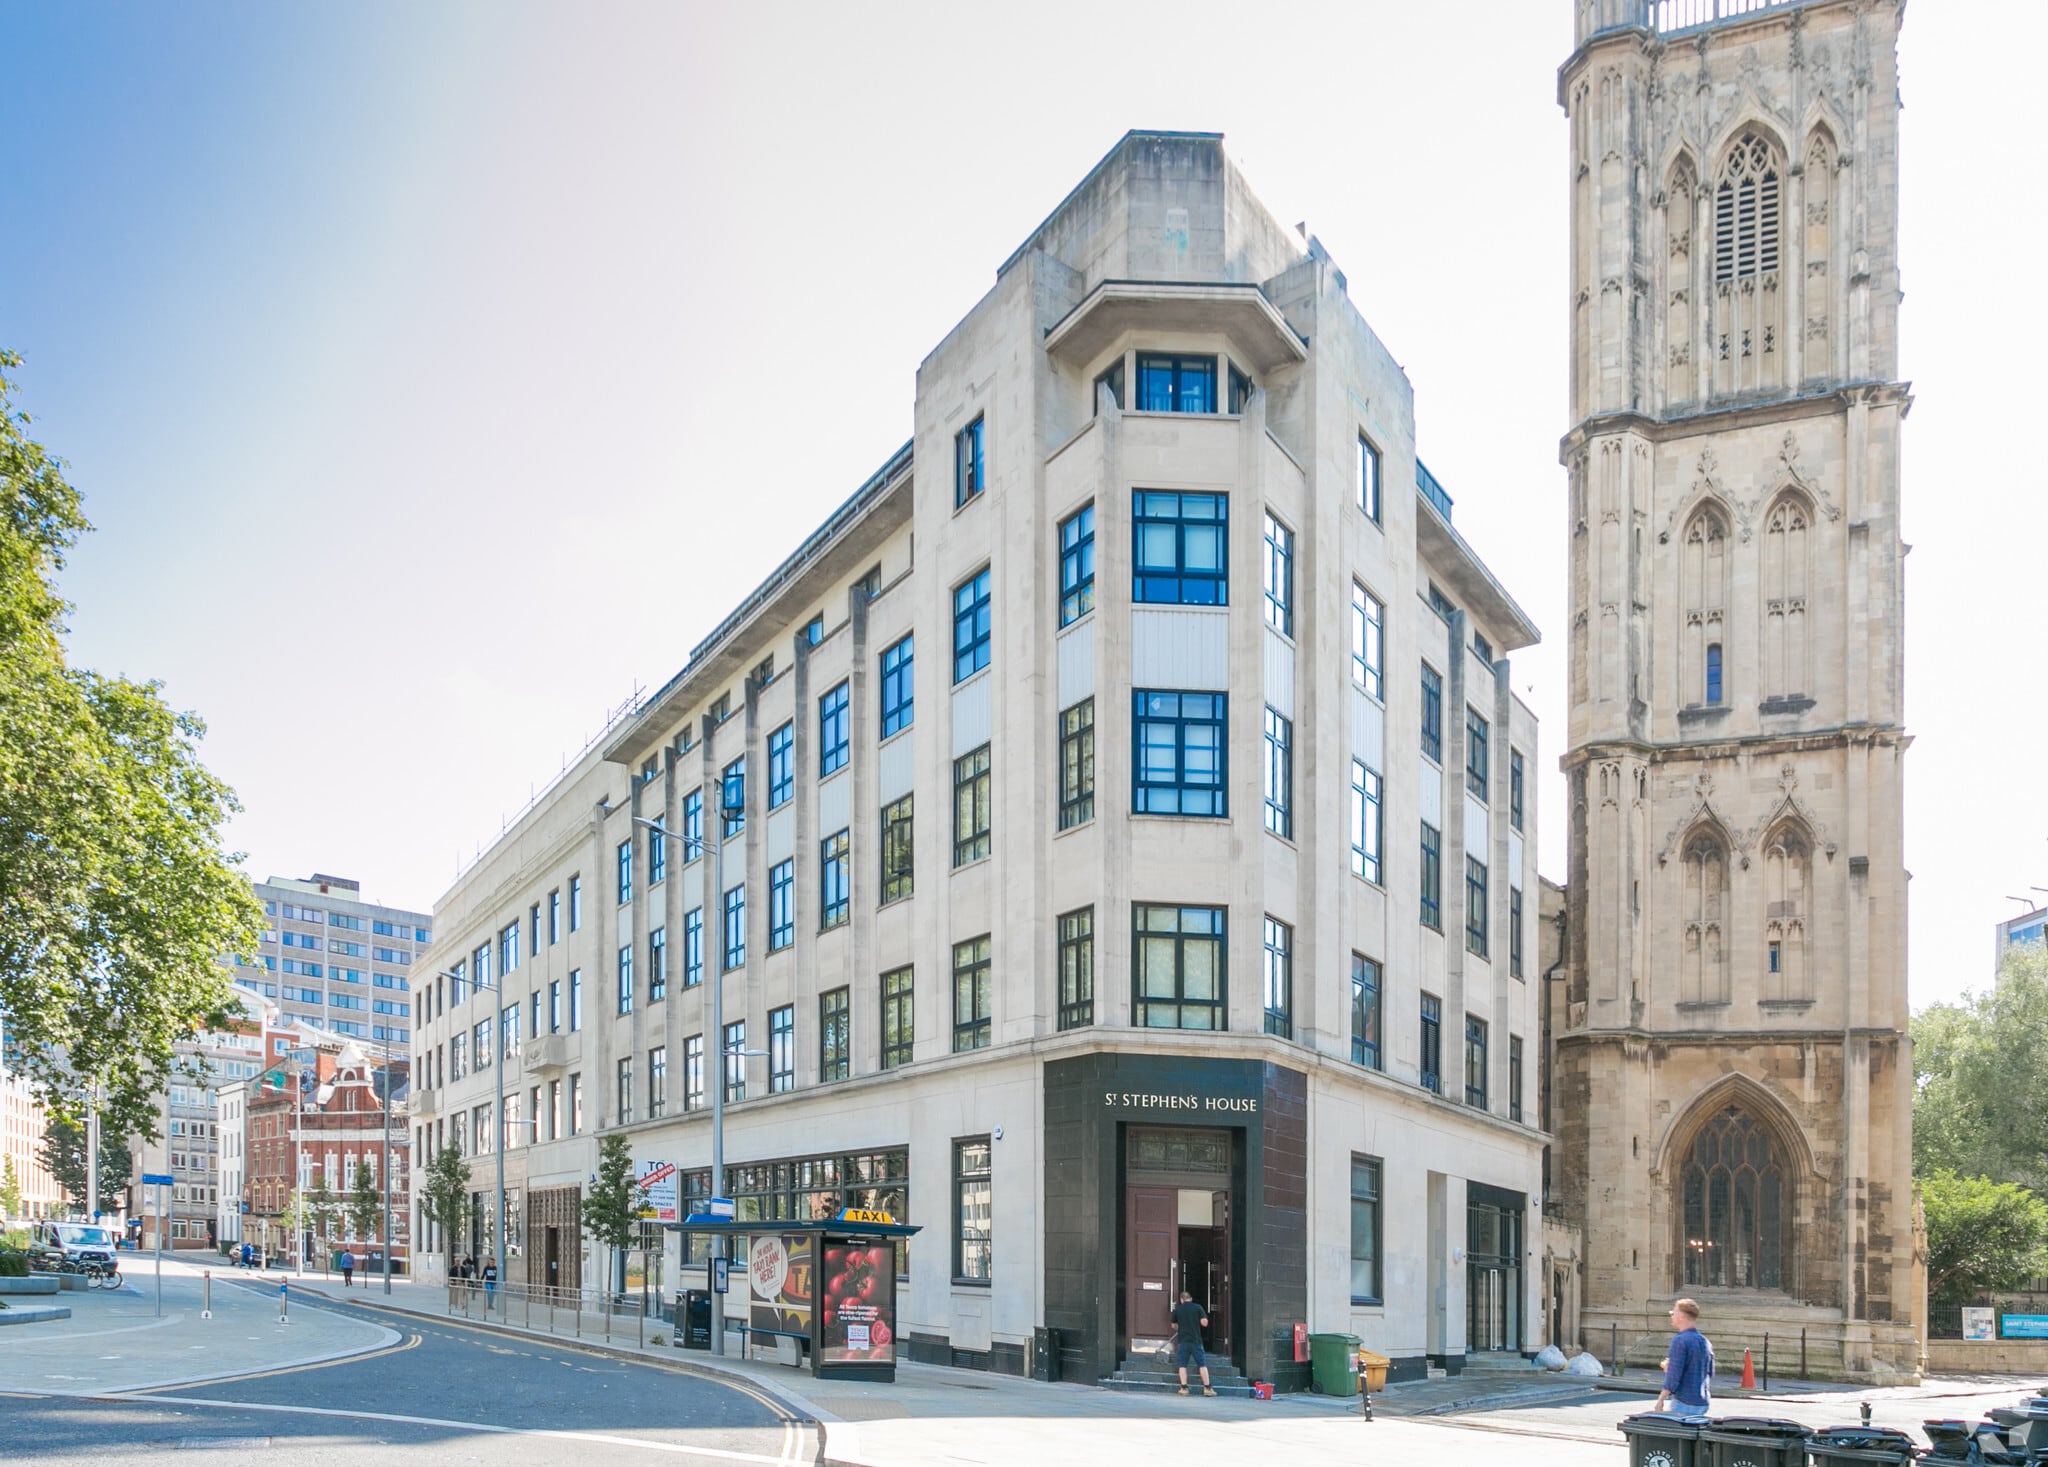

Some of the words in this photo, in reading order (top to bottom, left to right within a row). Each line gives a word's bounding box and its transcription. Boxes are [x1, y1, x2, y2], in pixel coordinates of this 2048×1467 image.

[1122, 1093, 1198, 1110] STEPHEN'S
[1205, 1097, 1257, 1112] HOUSE
[641, 1174, 658, 1186] UNDER
[657, 1165, 674, 1177] OFFER
[648, 1161, 665, 1171] TO
[852, 1210, 885, 1222] TAXI
[753, 1258, 765, 1274] TAXI
[765, 1250, 780, 1268] RANK
[760, 1264, 776, 1284] HERE!
[1645, 1450, 1674, 1463] BRISTOL
